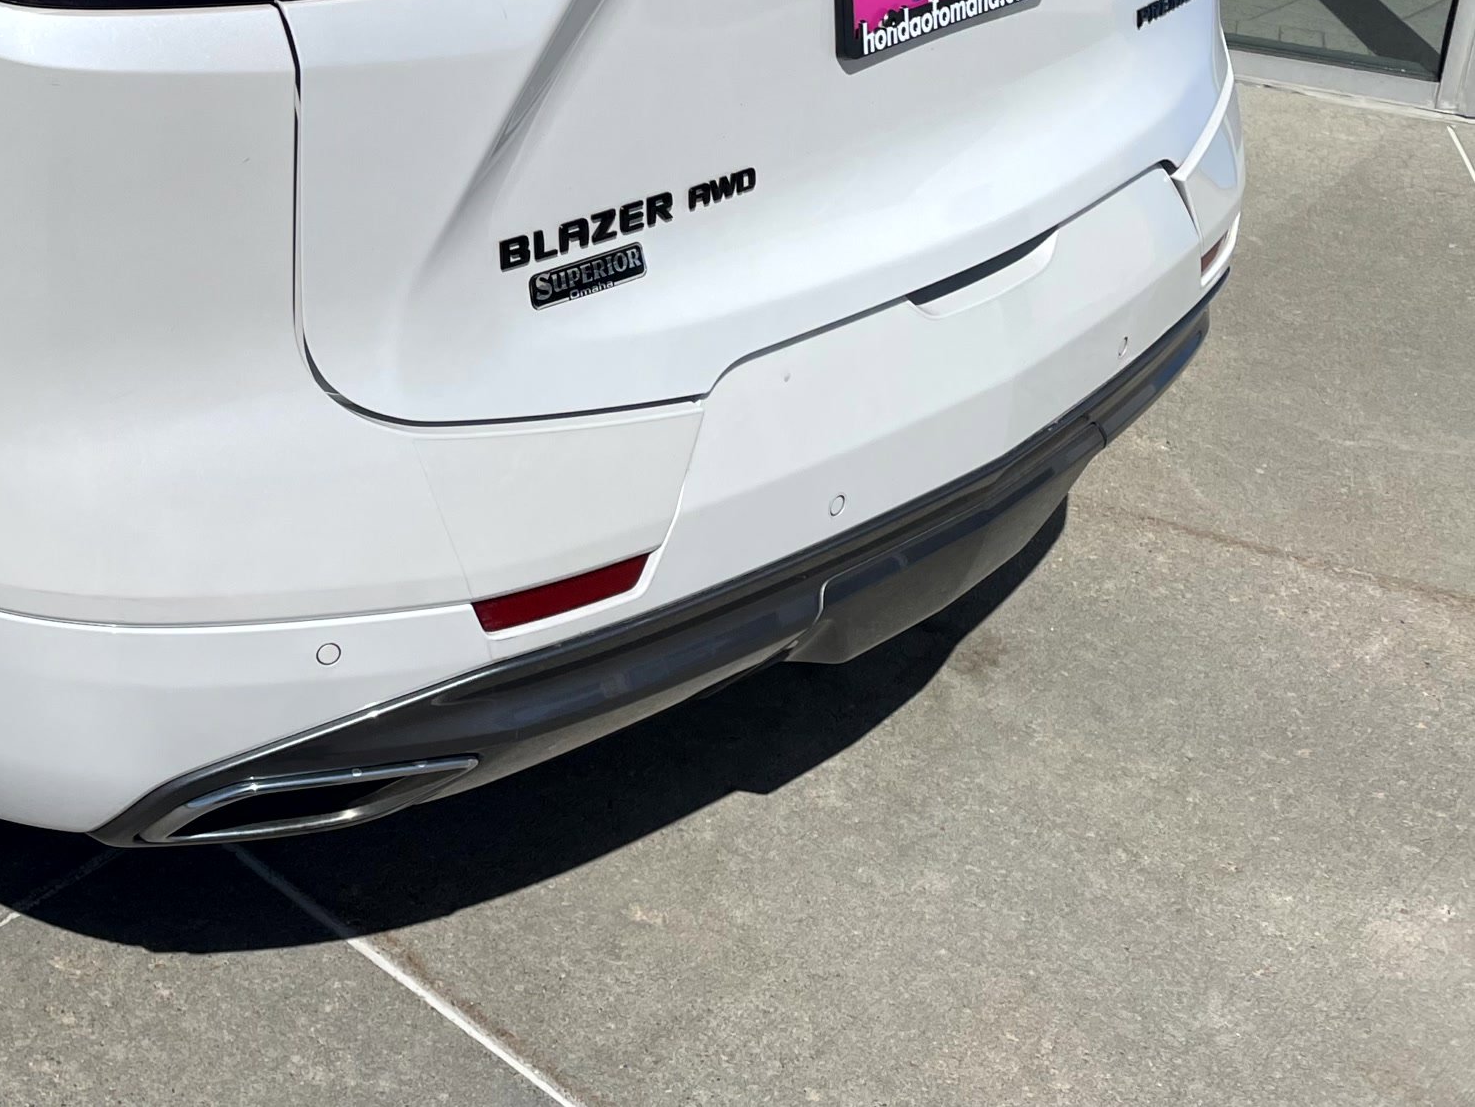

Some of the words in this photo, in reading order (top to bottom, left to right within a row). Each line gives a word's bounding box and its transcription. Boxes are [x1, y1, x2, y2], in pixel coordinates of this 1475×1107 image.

[499, 191, 674, 272] BLAZER
[688, 167, 757, 211] AWD
[535, 248, 642, 301] SUPERIOR
[569, 280, 615, 300] Omaha
